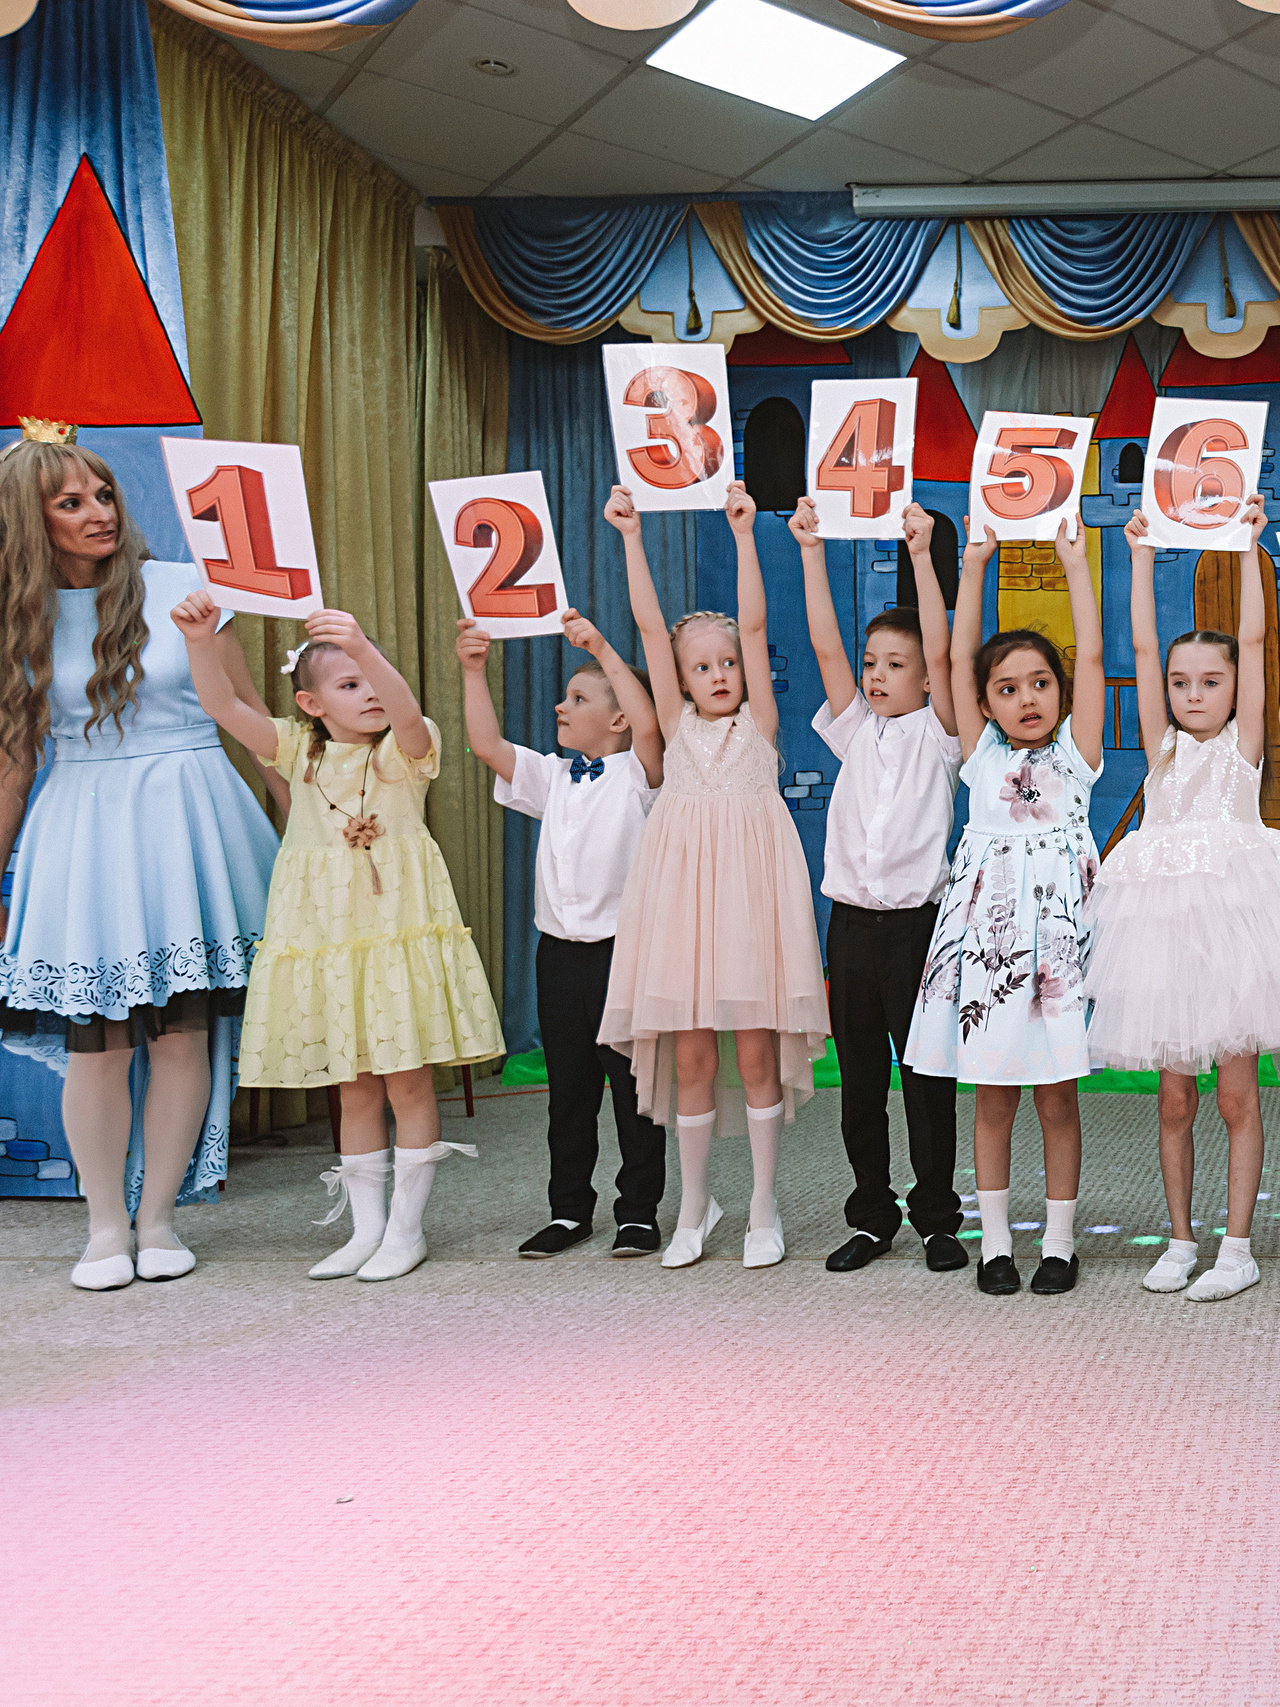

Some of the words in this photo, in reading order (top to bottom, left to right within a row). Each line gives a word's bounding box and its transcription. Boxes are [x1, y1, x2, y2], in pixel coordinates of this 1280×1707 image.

[623, 365, 725, 489] 3
[816, 398, 905, 518] 4
[980, 427, 1079, 520] 5
[1154, 418, 1249, 529] 6
[186, 465, 312, 600] 1
[454, 497, 558, 618] 2
